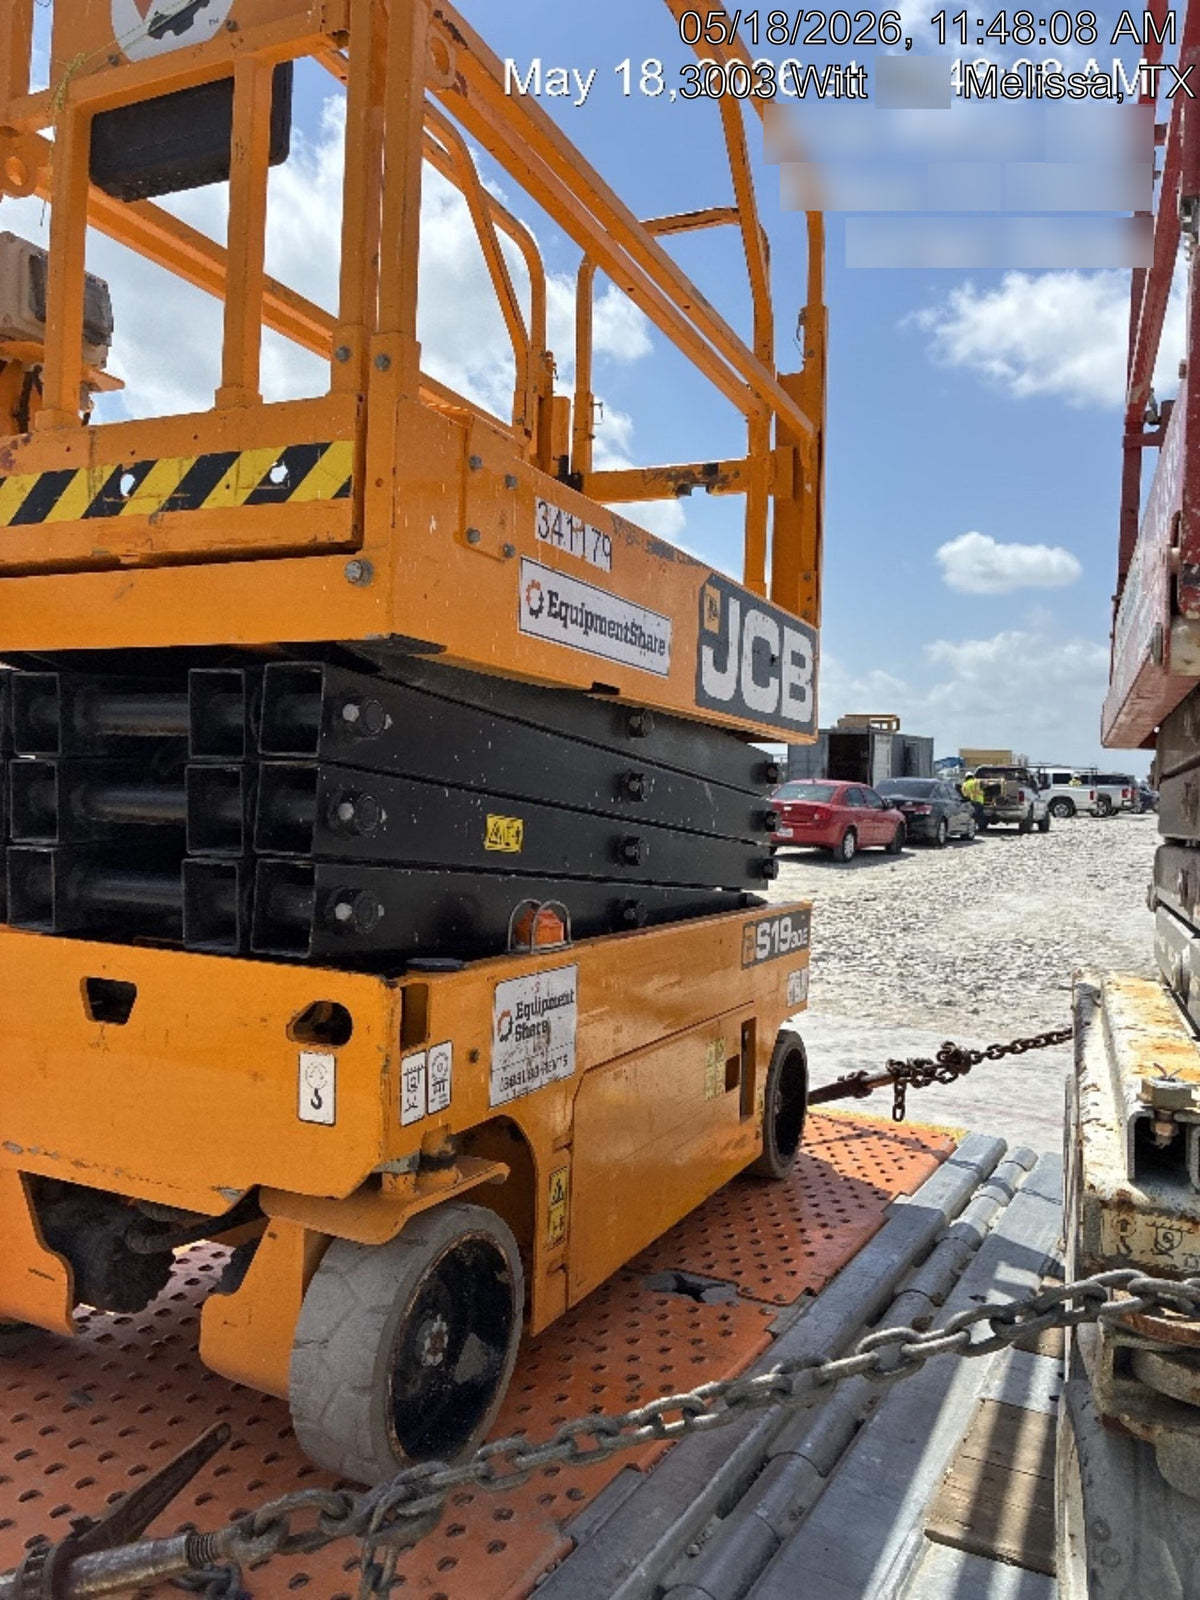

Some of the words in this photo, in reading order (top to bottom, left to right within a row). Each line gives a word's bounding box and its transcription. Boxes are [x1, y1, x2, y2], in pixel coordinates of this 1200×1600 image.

[536, 500, 613, 573] 341179
[546, 589, 667, 657] EquipmentShare
[701, 596, 815, 723] JCB
[514, 1019, 549, 1042] Share
[515, 989, 576, 1023] Equipment
